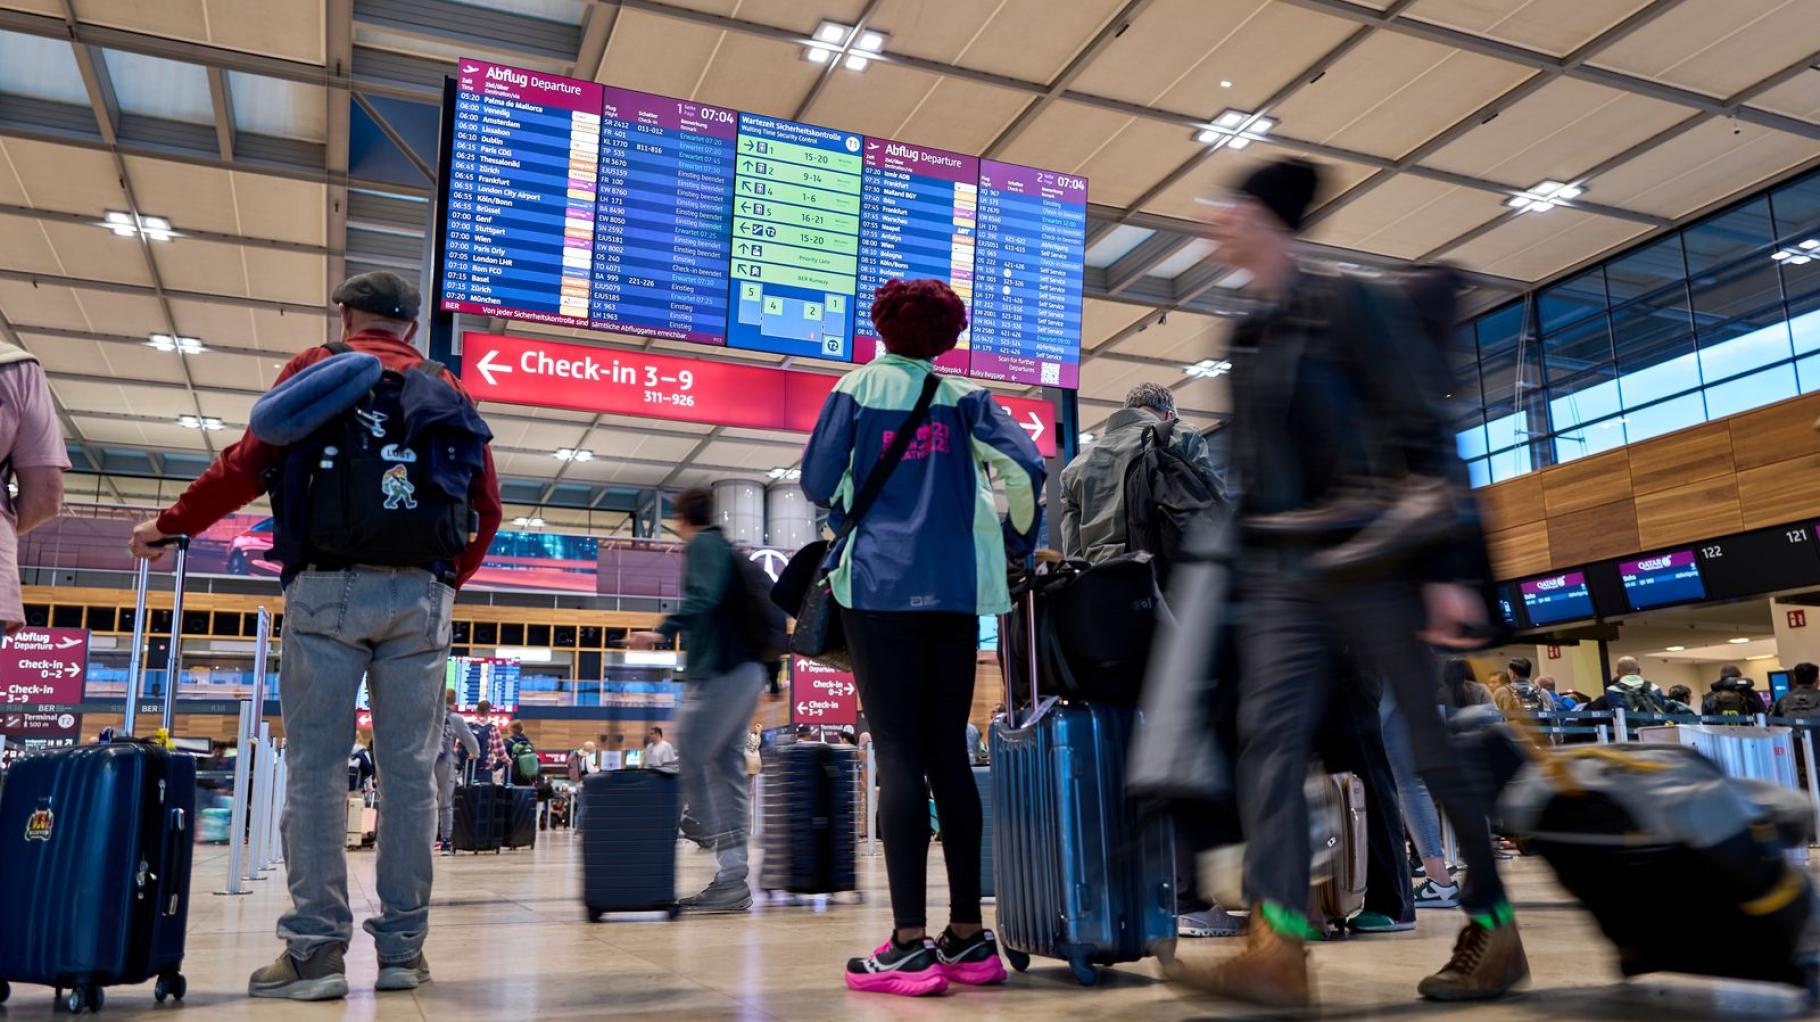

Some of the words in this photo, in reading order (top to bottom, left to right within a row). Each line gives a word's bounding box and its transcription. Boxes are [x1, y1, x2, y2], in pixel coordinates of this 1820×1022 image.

[486, 67, 528, 87] Abflug
[531, 77, 581, 96] Departure
[461, 92, 480, 102] 05:20
[484, 96, 504, 106] Palma
[516, 102, 543, 113] Mallorca
[460, 102, 479, 111] 06:00
[484, 106, 510, 118] Venedig
[677, 103, 682, 114] 1
[701, 108, 734, 124] 07:04
[459, 112, 478, 121] 06:00
[483, 116, 520, 128] Amsterdam
[459, 122, 478, 131] 06:00
[482, 125, 511, 136] Lissabon
[742, 116, 775, 129] Wartezeit
[776, 123, 841, 141] Sicherheitskontrolle
[742, 125, 762, 135] Waiting
[776, 132, 798, 142] Security
[798, 136, 818, 145] Control
[458, 132, 477, 141] 06:10
[482, 135, 504, 145] Dublin
[456, 151, 475, 160] 06:25
[457, 142, 476, 150] 06:15
[481, 145, 497, 154] Paris
[498, 148, 512, 156] CDG
[770, 147, 774, 155] 1
[804, 153, 828, 164] 15-20
[885, 143, 919, 162] Abflug
[921, 152, 962, 170] Departure
[456, 161, 475, 170] 06:45
[480, 165, 500, 174] Zürich
[455, 171, 474, 180] 06:45
[479, 175, 510, 186] Frankfurt
[768, 168, 774, 176] 2
[803, 173, 822, 184] 9-14
[1036, 172, 1043, 183] 2
[1057, 176, 1085, 191] 07:04
[454, 181, 473, 190] 06:55
[478, 185, 502, 195] London
[504, 189, 516, 198] City
[518, 191, 540, 202] Airport
[454, 191, 473, 200] 06:55
[477, 194, 512, 206] Köln/Bonn
[802, 193, 816, 203] 1-6
[453, 201, 472, 210] 06:55
[477, 204, 500, 214] Brüssel
[452, 211, 471, 220] 07:00
[476, 214, 492, 223] Genf
[767, 208, 772, 216] 5
[801, 213, 824, 224] 16-21
[451, 221, 470, 230] 07:00
[475, 224, 506, 236] Stuttgart
[450, 231, 470, 240] 07:00
[474, 234, 492, 243] Wien
[800, 234, 824, 245] 15-20
[450, 241, 469, 250] 07:00
[474, 244, 490, 253] Paris
[491, 247, 506, 256] Orly
[449, 251, 468, 260] 07:05
[473, 254, 498, 264] London
[499, 258, 512, 266] LHR
[448, 261, 468, 270] 07:10
[472, 264, 488, 273] Rom
[489, 267, 502, 275] FCO
[448, 271, 467, 280] 07:15
[472, 274, 490, 283] Basel
[629, 277, 654, 287] 221-226
[447, 282, 466, 290] 07:15
[471, 284, 492, 294] Zürich
[748, 288, 754, 297] 5
[446, 292, 465, 300] 07:20
[470, 294, 501, 305] München
[833, 300, 837, 308] 1
[770, 302, 777, 310] 4
[809, 307, 816, 316] 2
[496, 308, 513, 318] jeder
[514, 311, 575, 325] Sicherheitskontrolle
[576, 319, 588, 327] sind
[592, 320, 620, 330] sämtliche
[621, 324, 657, 335] Abfluggates
[520, 351, 636, 384] Check-in
[1786, 528, 1807, 543] 121
[1702, 545, 1723, 559] 122
[1638, 559, 1662, 570] QATAR
[14, 632, 50, 644] Abflug
[14, 642, 54, 650] Departure
[18, 660, 63, 669] Check-in
[8, 684, 54, 694] Check-in
[813, 680, 844, 688] Check-in
[808, 700, 839, 708] Check-in
